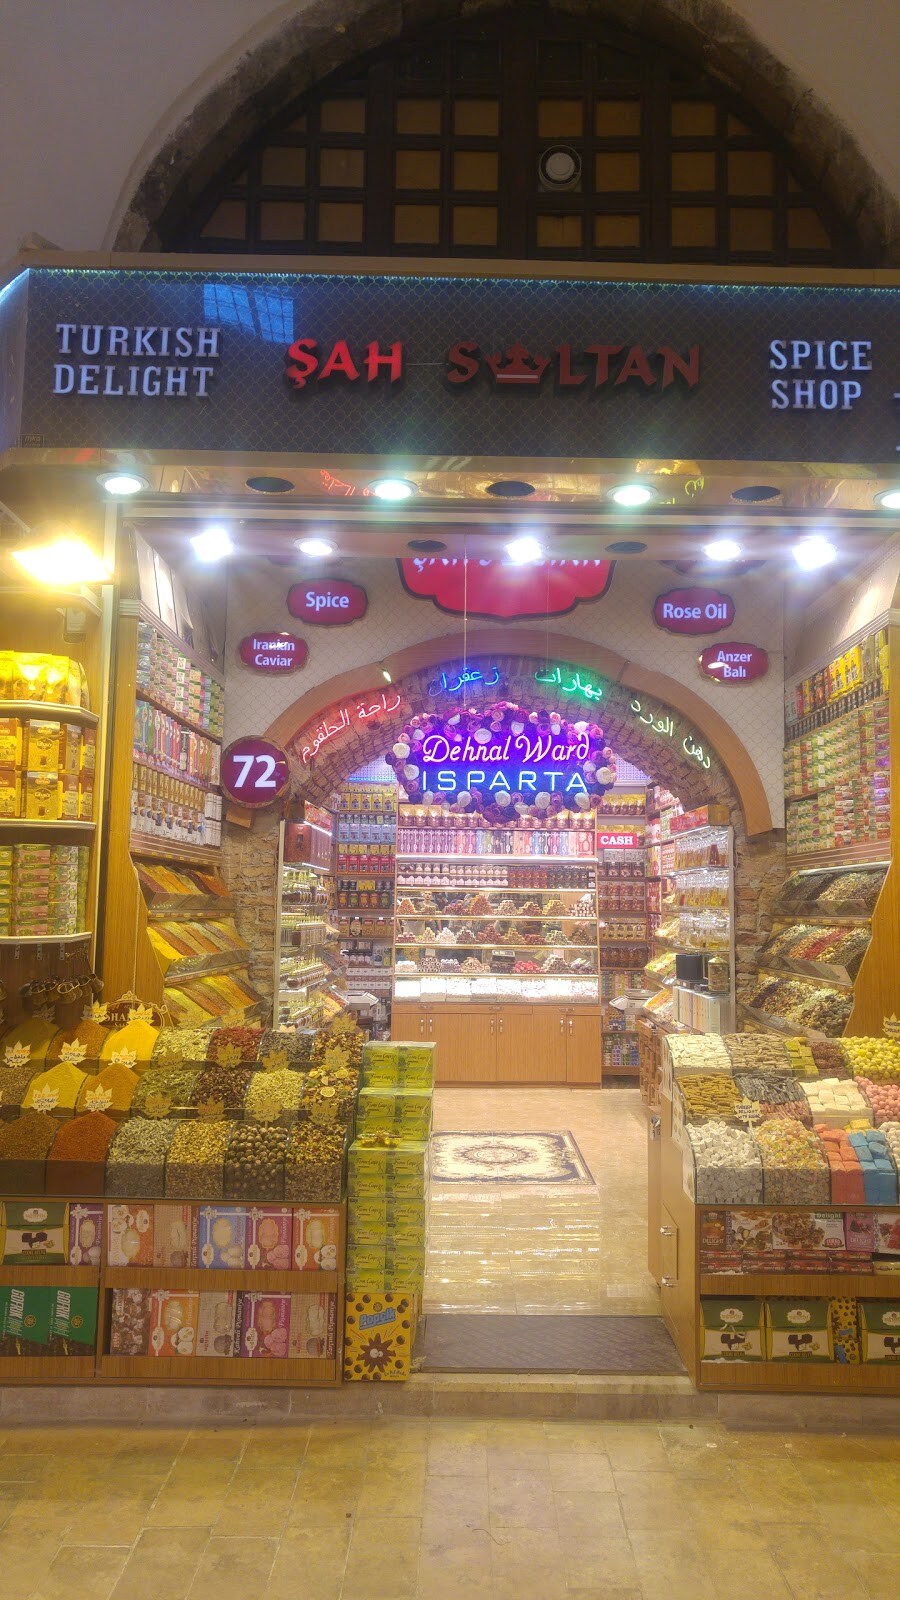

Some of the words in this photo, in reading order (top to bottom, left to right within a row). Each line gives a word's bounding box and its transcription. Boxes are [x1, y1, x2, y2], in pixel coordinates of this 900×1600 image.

[55, 323, 220, 357] TURKISH
[769, 339, 873, 371] SPICE
[286, 338, 402, 389] ŞAH
[446, 341, 700, 388] SLTAN
[53, 364, 214, 397] DELIGHT
[770, 380, 863, 411] SHOP
[305, 592, 350, 611] Spice
[663, 603, 701, 619] Rose
[704, 603, 727, 620] Oil
[254, 654, 293, 667] Caviar
[717, 651, 753, 662] Anzer
[534, 667, 603, 701] بهارات
[356, 694, 401, 719] راحة
[630, 699, 674, 737] الورد
[302, 708, 351, 764] الحلقوم
[422, 735, 512, 763] Dehnal
[514, 732, 590, 764] Ward
[232, 754, 277, 788] 72
[421, 770, 588, 792] ISPARTA
[600, 835, 634, 845] CASH
